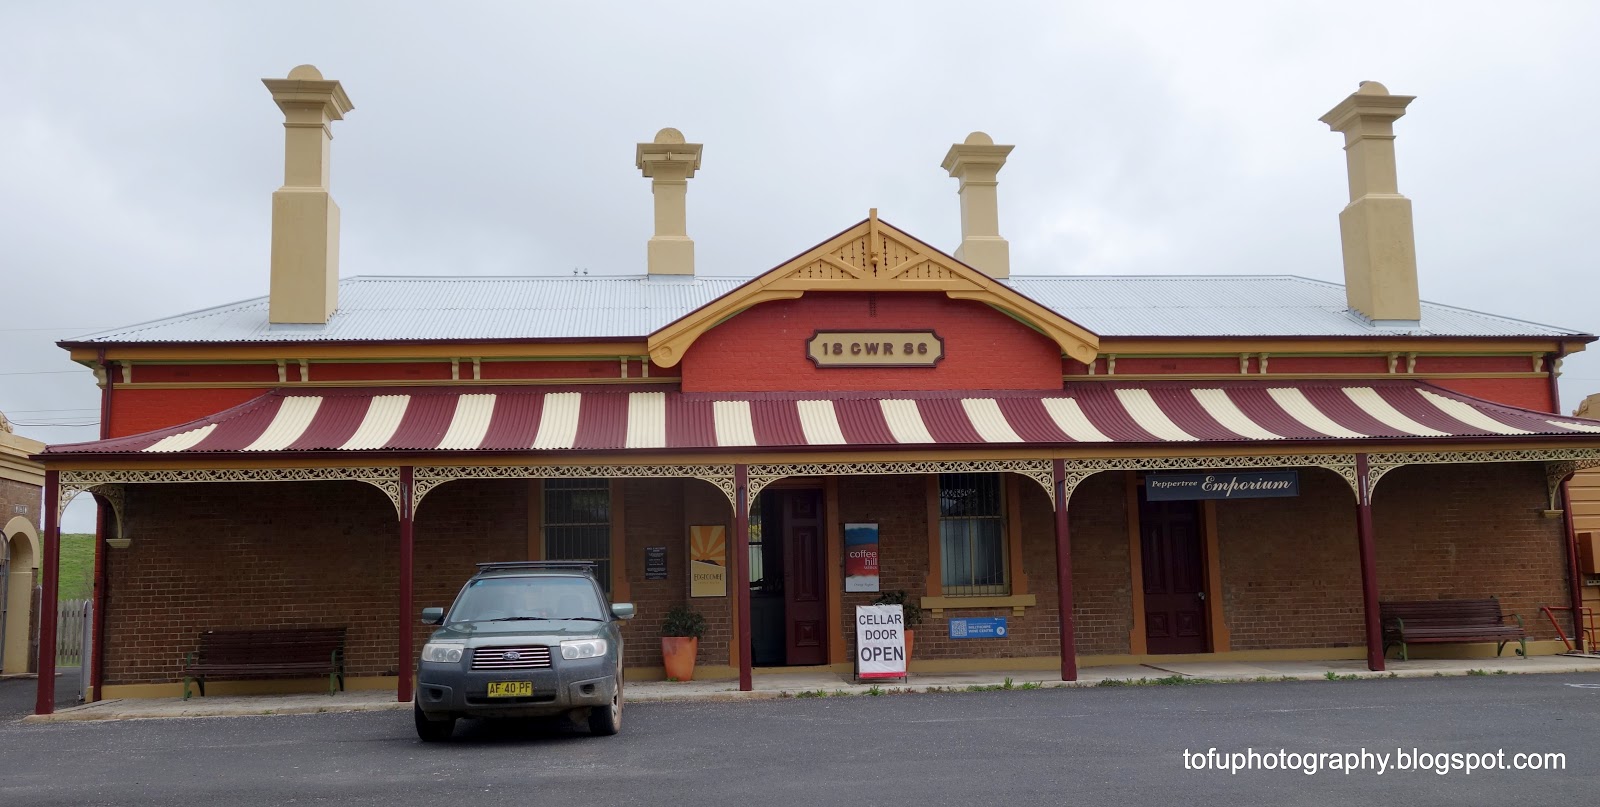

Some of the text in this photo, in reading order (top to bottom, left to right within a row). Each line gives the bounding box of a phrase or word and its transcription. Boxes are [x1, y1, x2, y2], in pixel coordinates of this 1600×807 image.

[822, 342, 928, 355] 18 GWR 86
[1151, 475, 1293, 497] Peppertree Emporium
[849, 550, 877, 558] coffee
[864, 557, 878, 566] hill
[858, 614, 902, 625] CELLAR
[865, 629, 897, 640] DOOR
[860, 646, 904, 662] OPEN
